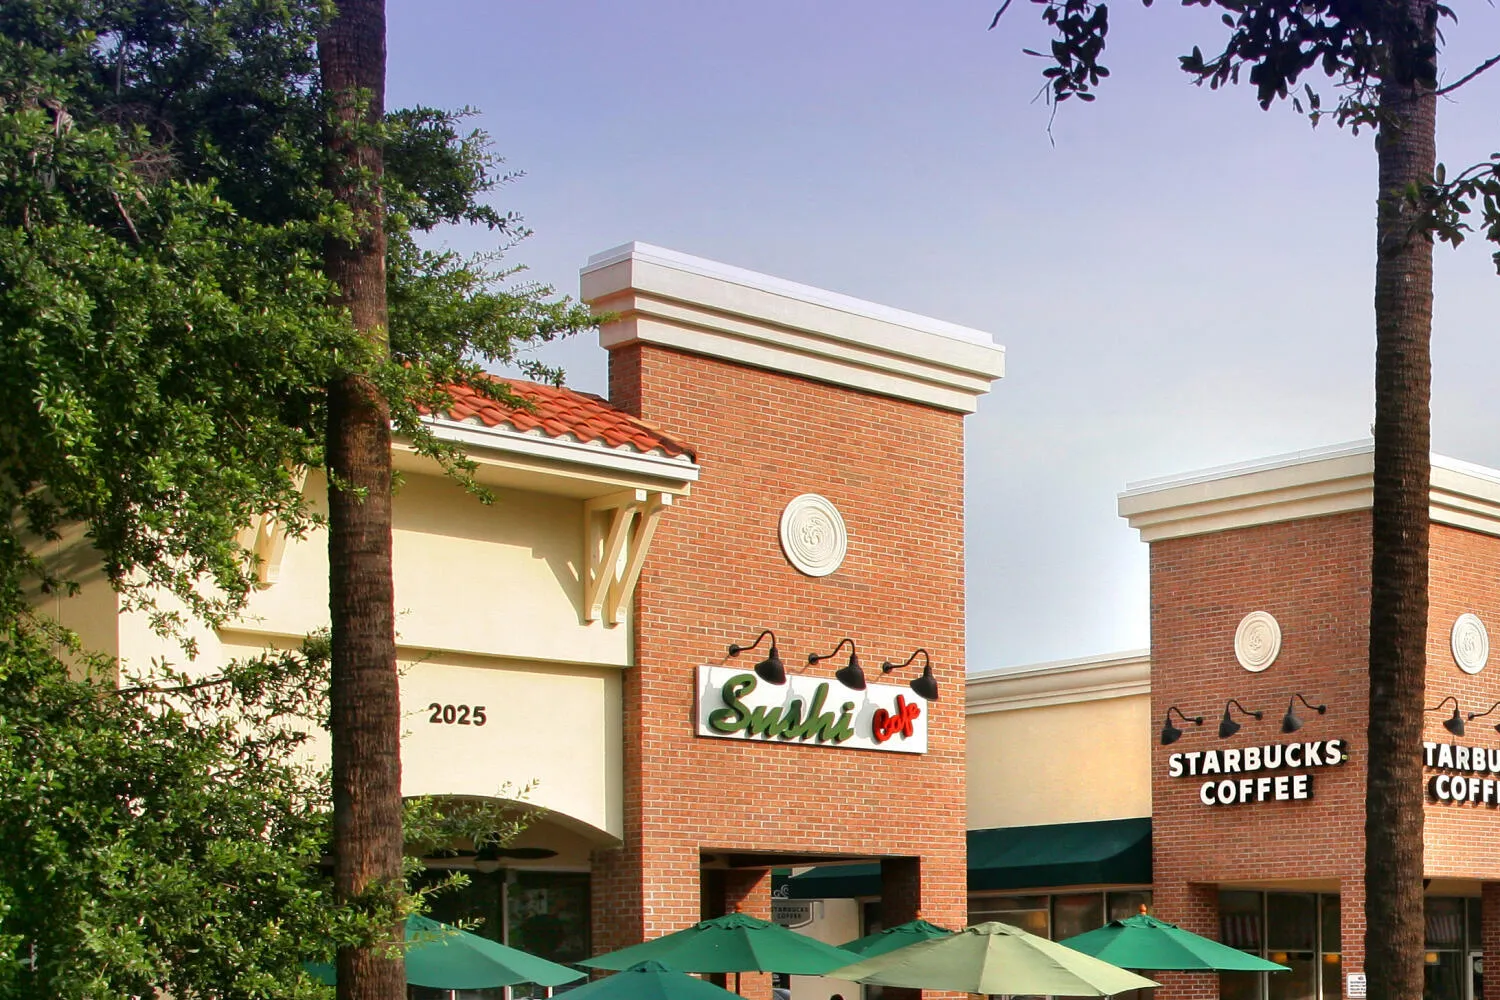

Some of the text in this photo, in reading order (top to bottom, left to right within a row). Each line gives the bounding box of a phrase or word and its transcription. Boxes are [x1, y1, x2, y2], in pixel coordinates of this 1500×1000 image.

[428, 702, 487, 727] 2025
[709, 673, 855, 744] Sushi
[1168, 739, 1343, 778] STARBUCKS
[1200, 774, 1309, 806] COFFEE
